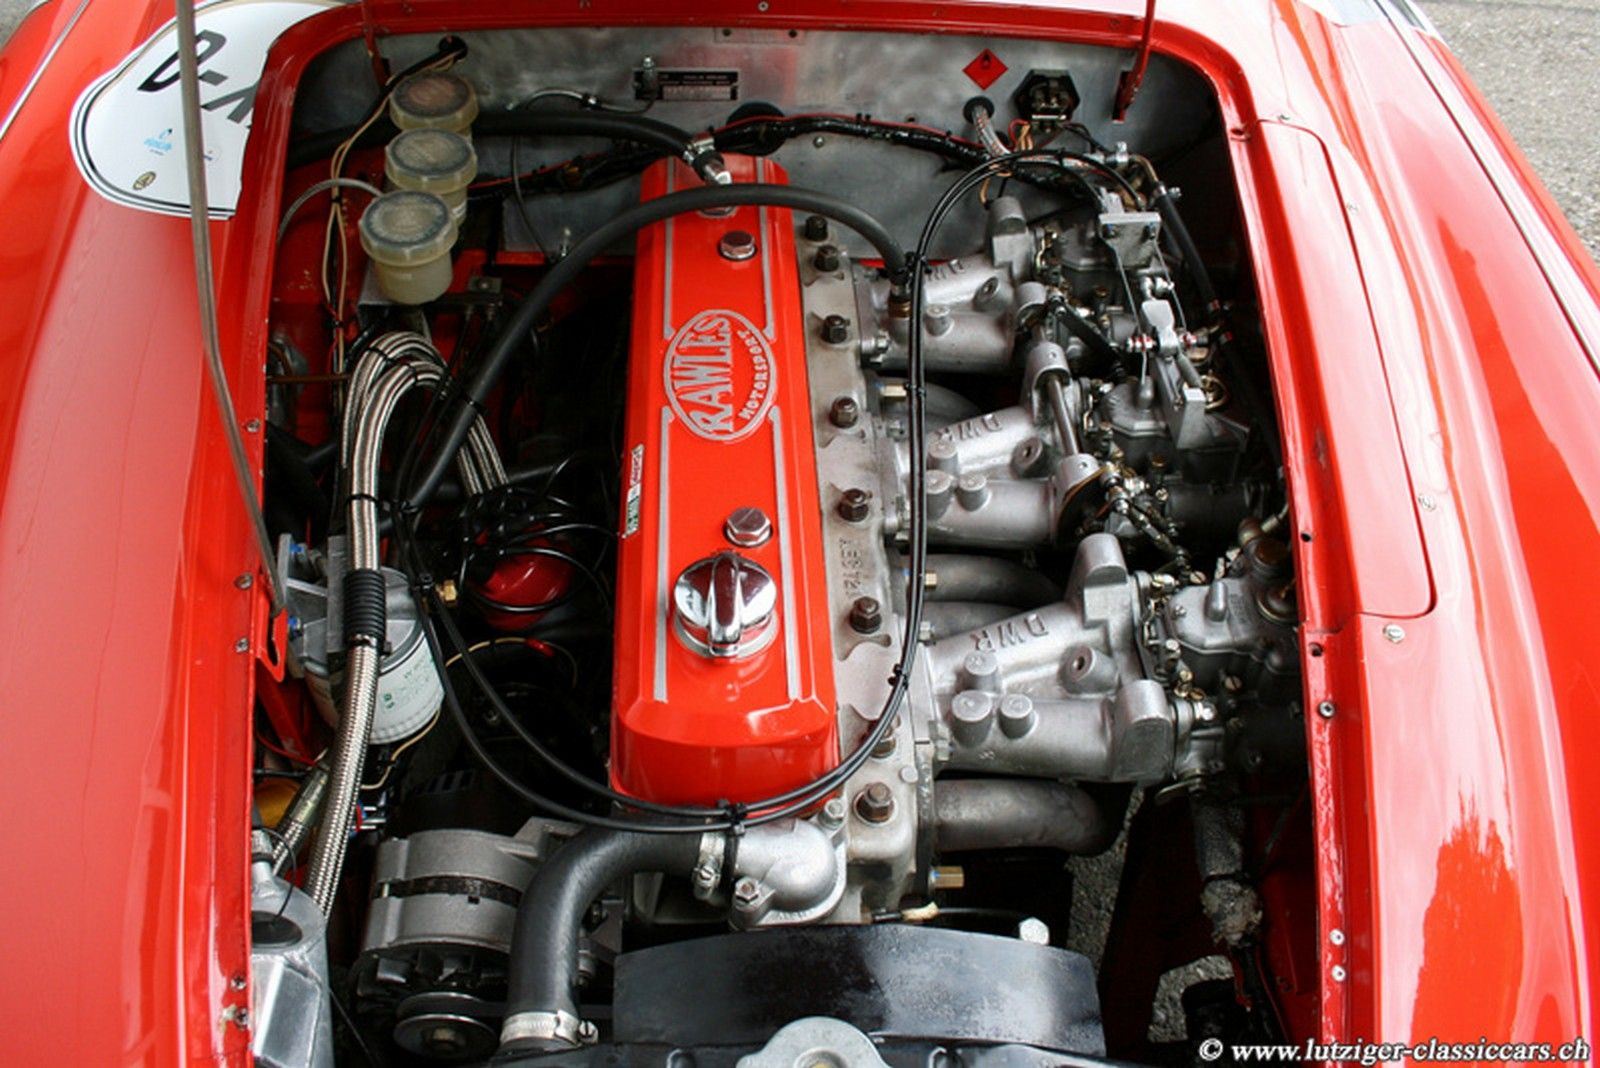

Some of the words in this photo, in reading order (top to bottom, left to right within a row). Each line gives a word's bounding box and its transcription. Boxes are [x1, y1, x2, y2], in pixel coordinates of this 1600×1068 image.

[671, 317, 733, 433] RAWLES
[736, 329, 769, 420] MOTORSPORT
[968, 612, 1049, 653] DWR
